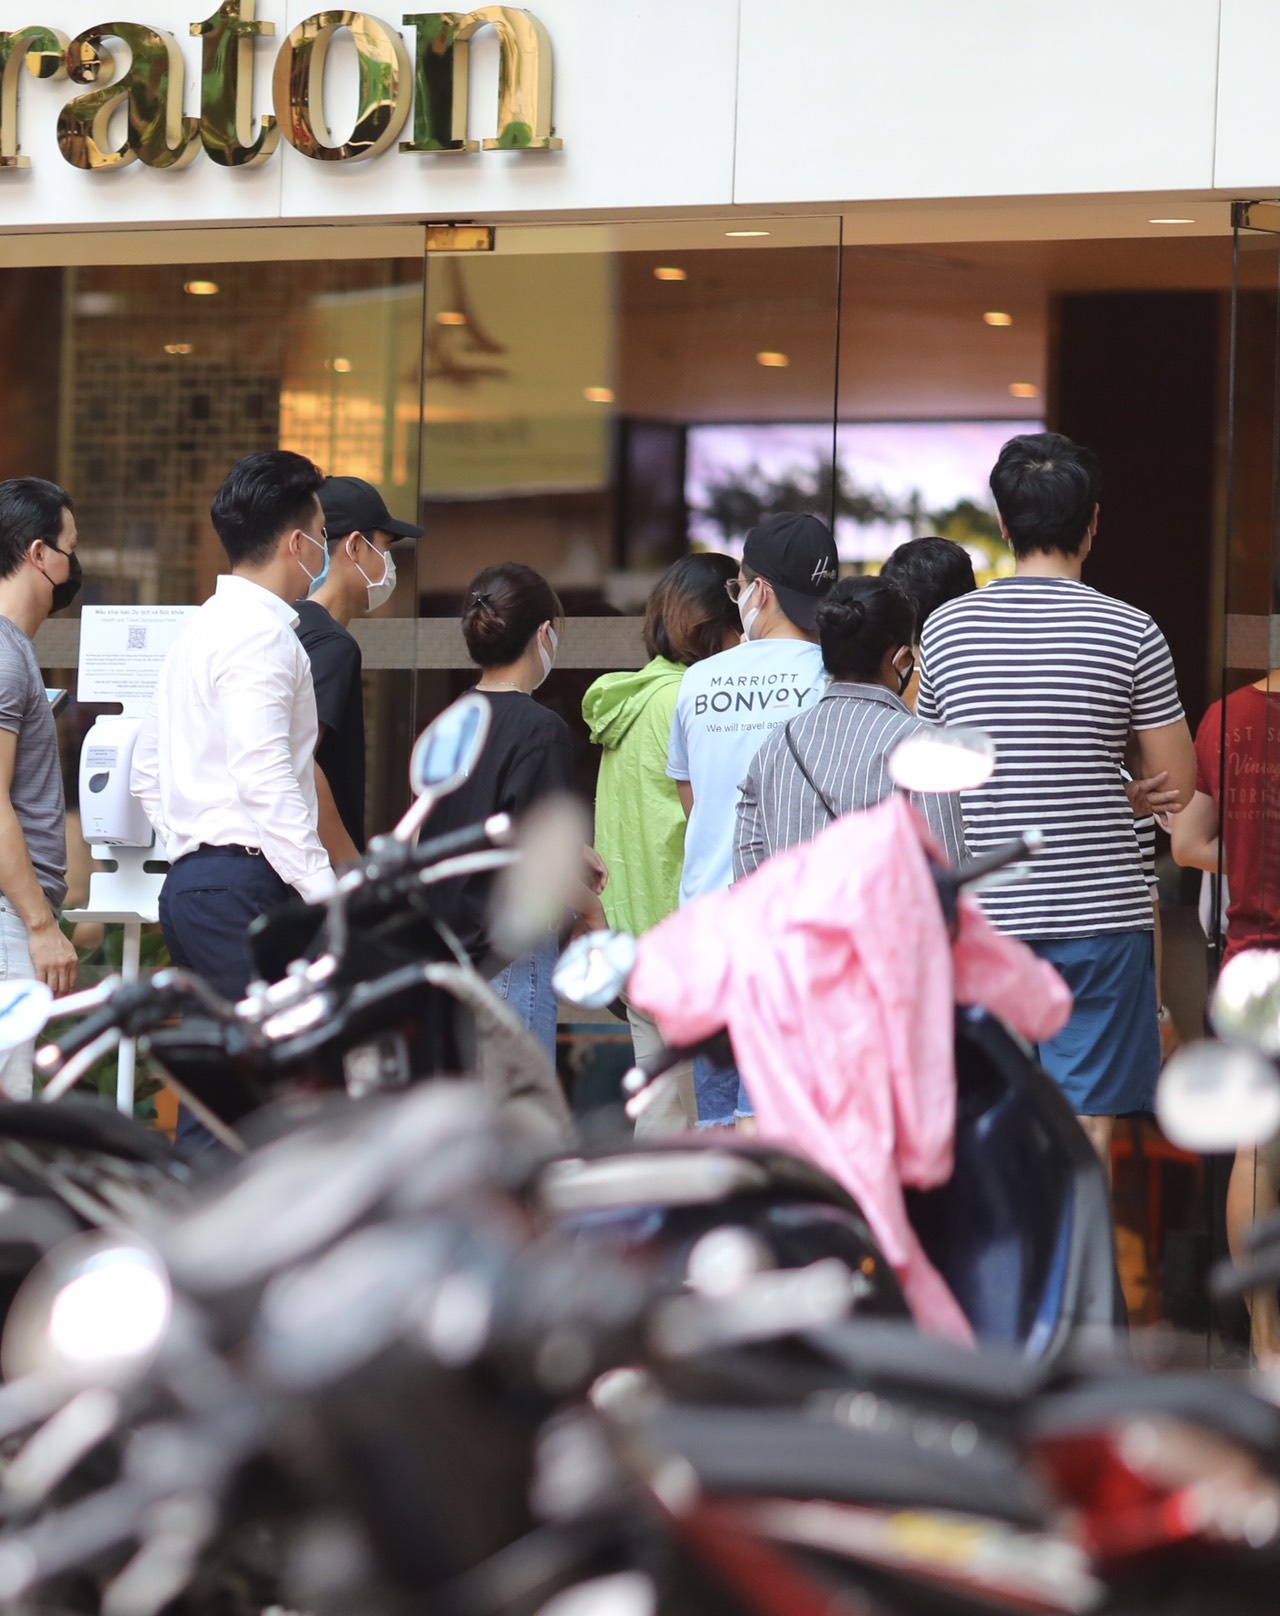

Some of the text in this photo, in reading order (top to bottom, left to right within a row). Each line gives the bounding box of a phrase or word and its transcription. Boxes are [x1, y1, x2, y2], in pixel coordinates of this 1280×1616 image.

[710, 673, 799, 687] MARRIOTT
[695, 687, 812, 715] BONVOY
[706, 720, 787, 733] We will travel aga
